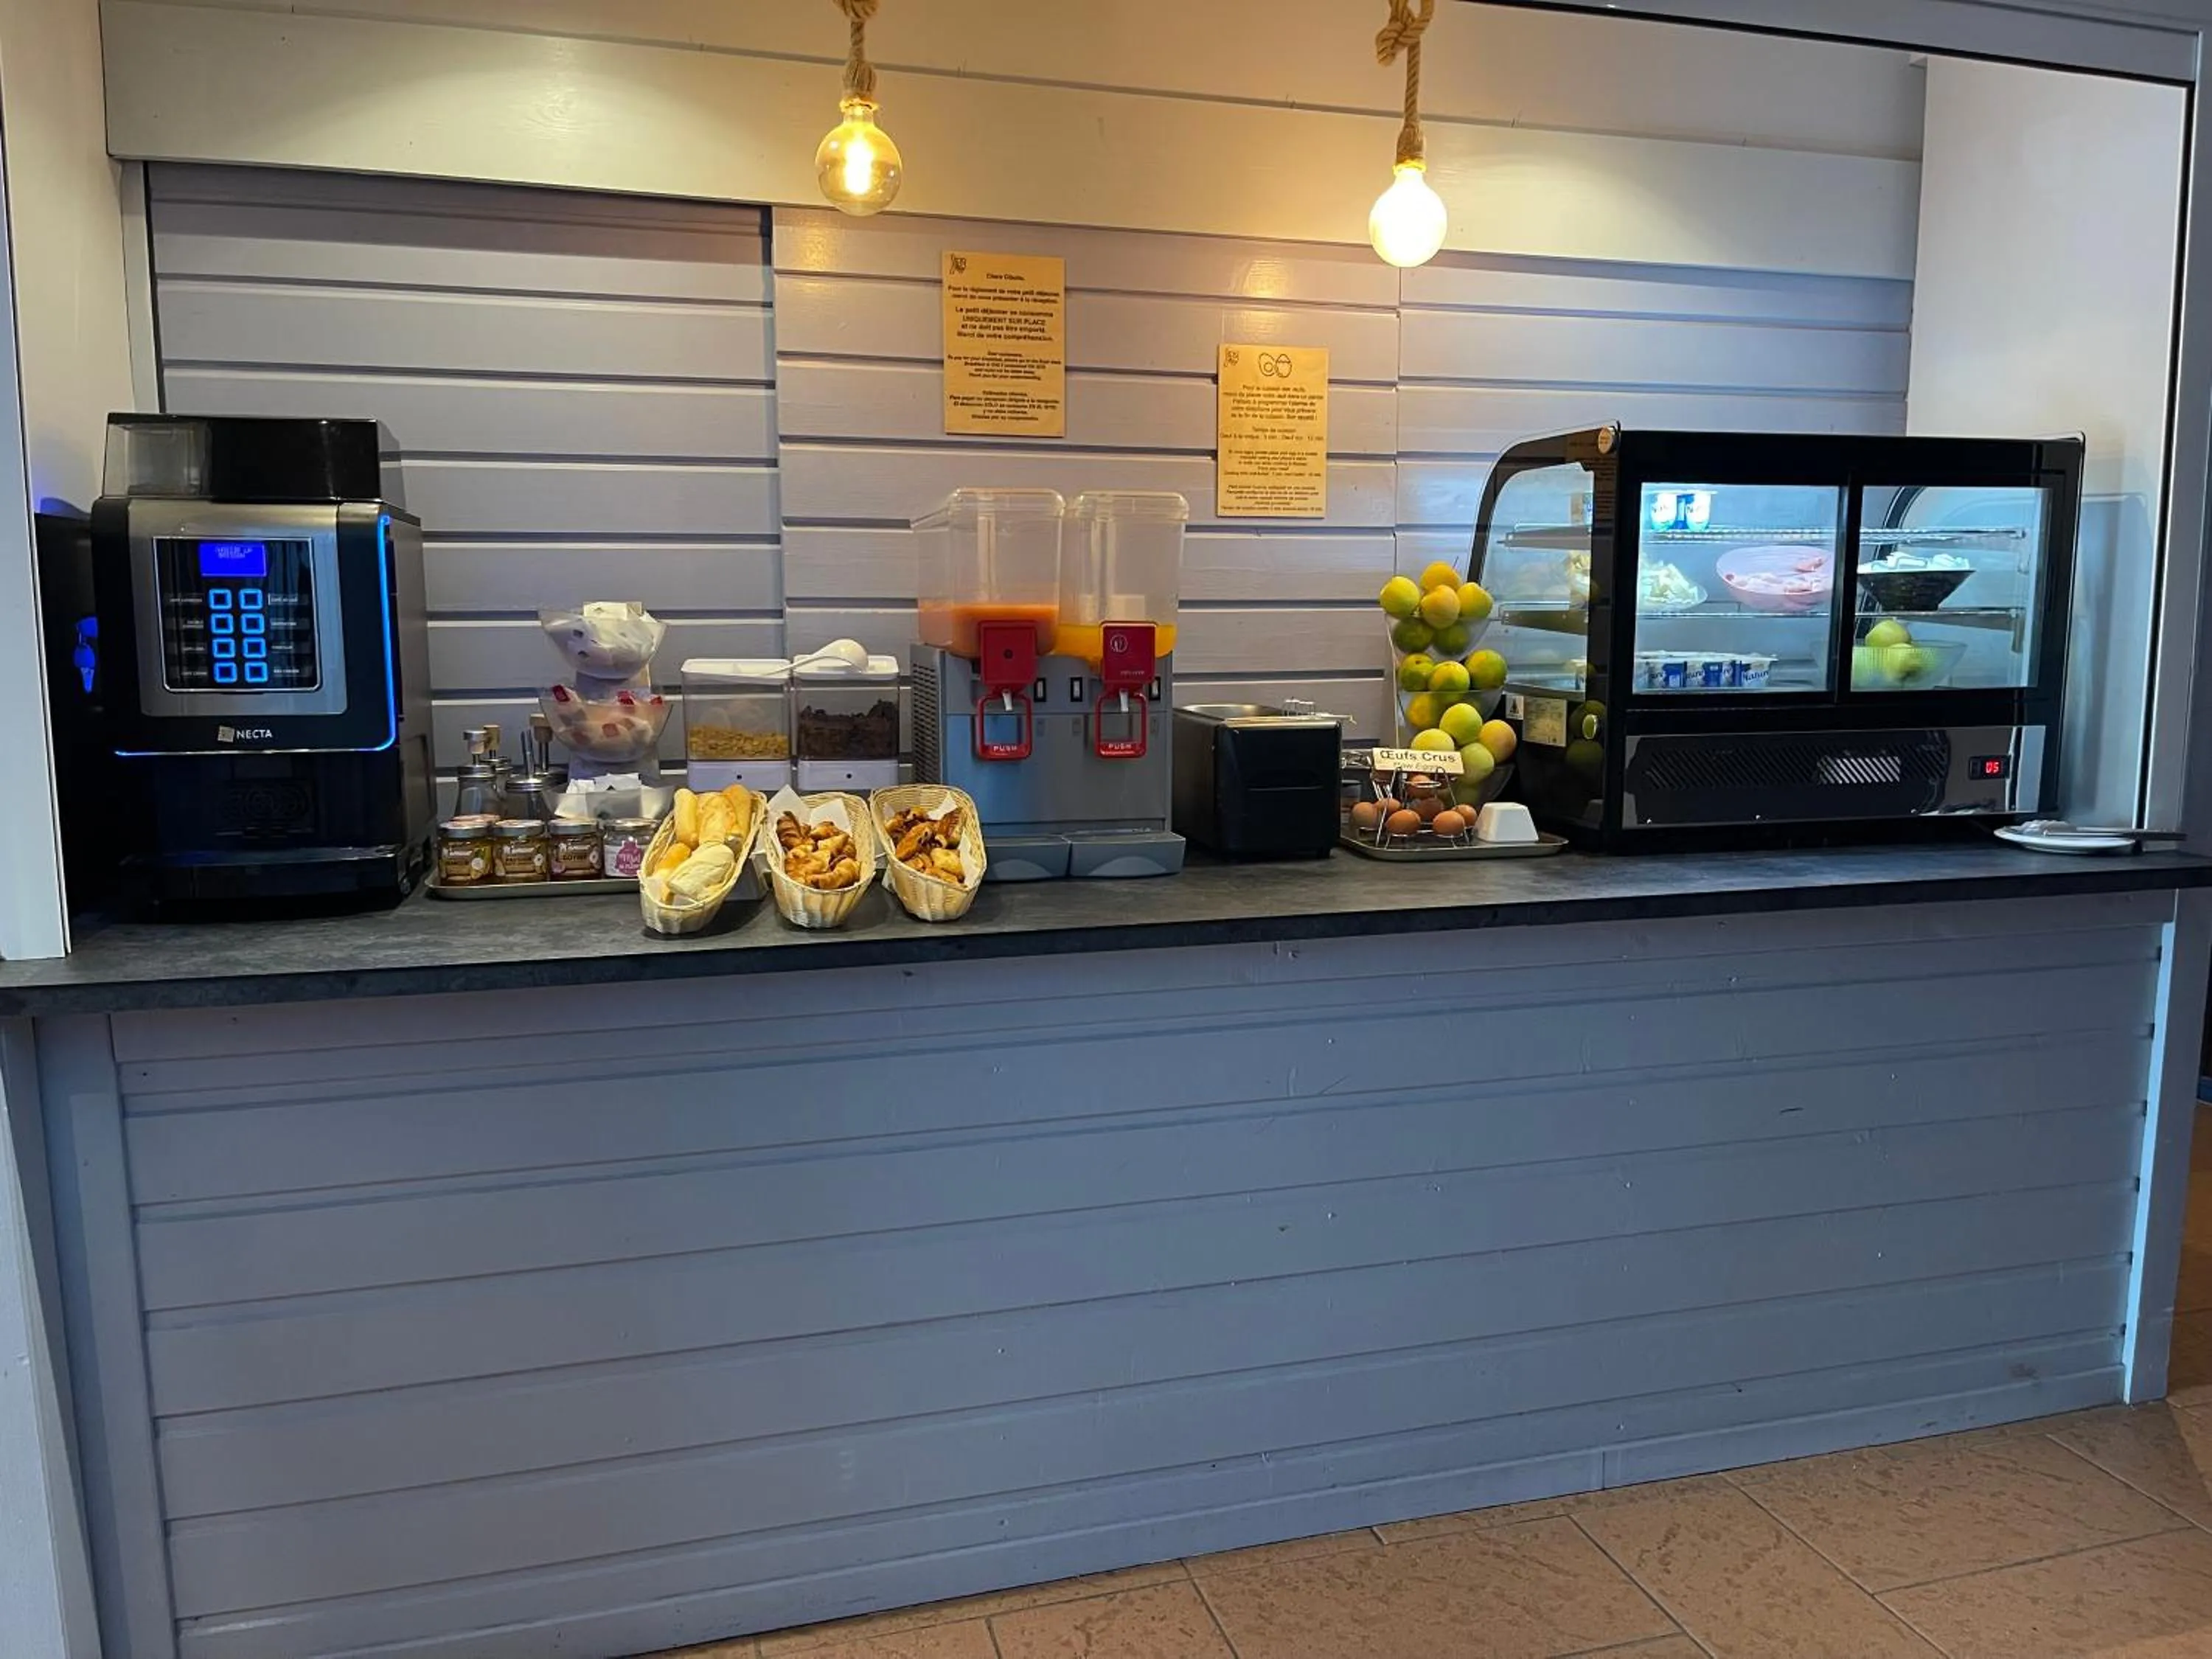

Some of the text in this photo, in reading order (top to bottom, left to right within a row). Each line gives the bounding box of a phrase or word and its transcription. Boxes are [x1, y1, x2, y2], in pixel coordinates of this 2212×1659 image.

[236, 728, 273, 740] NECTA
[1108, 742, 1132, 751] PUSH
[1422, 751, 1456, 763] Crus
